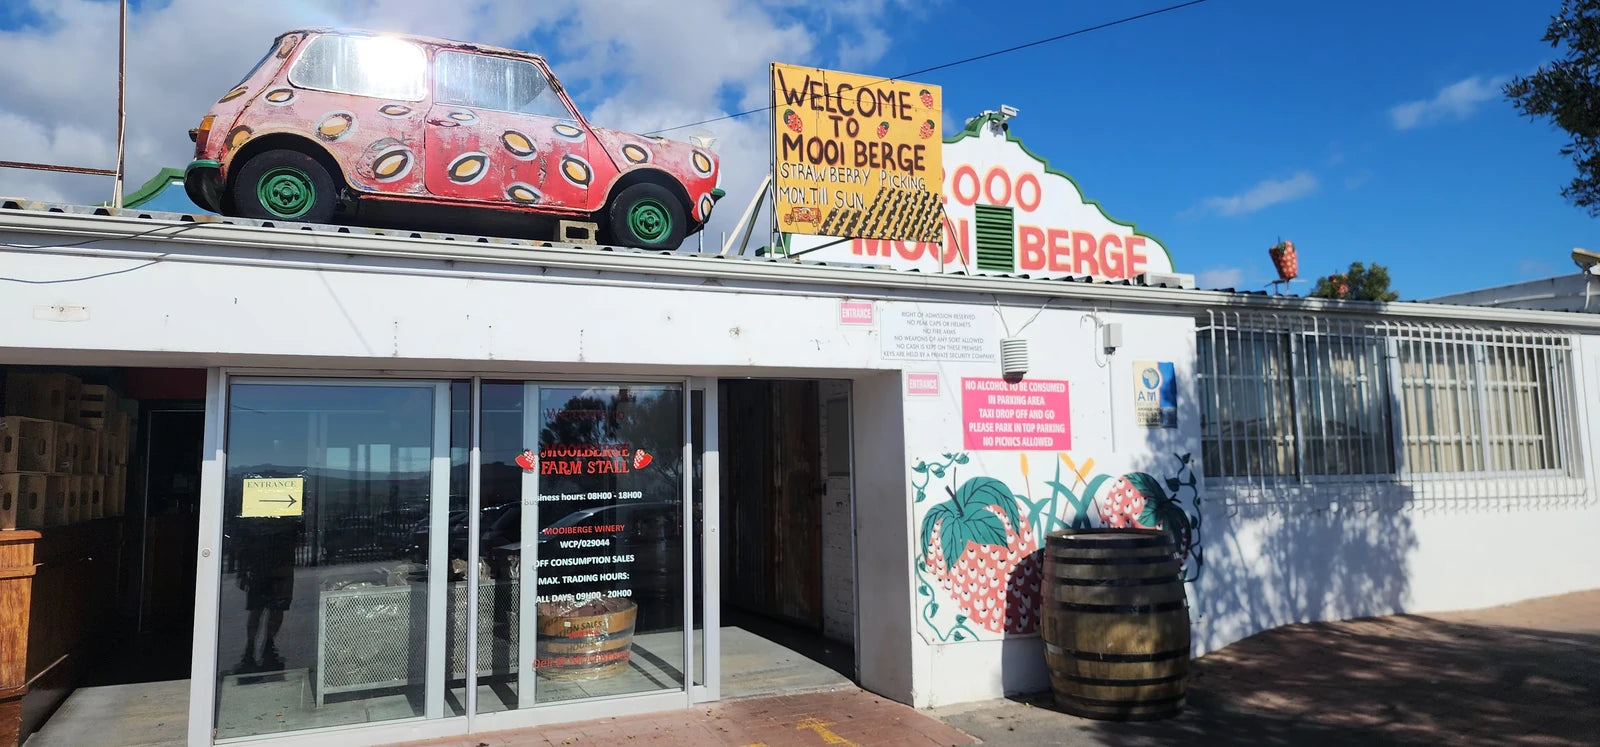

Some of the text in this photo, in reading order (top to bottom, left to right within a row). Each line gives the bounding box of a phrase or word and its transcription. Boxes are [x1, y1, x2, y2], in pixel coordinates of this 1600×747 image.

[778, 69, 912, 120] WELCOME
[829, 115, 859, 137] TO
[782, 133, 925, 176] MOOI BERGE
[942, 163, 1042, 212] 000
[1019, 224, 1148, 279] BERGE
[842, 308, 871, 319] ENTRANCE
[909, 379, 937, 389] ENTRANCE
[965, 380, 1066, 393] NO ALCOHOL TO BE CONSUMED
[988, 394, 1046, 406] IN PARKING AREA
[979, 408, 1055, 420] TAXI DROP OFF AND GO
[969, 422, 1066, 434] PLEASE PARK IN TOP PARKING
[982, 436, 1054, 447] NO PICNICS ALLOWED
[541, 460, 630, 476] FARM STALL
[247, 480, 296, 488] ENTRANCE
[562, 492, 586, 501] hours:
[588, 492, 612, 500] 08H00
[618, 491, 642, 499] 18H00
[544, 524, 626, 535] MOOIBERGE WINERY
[560, 538, 610, 550] WCP/029044
[533, 554, 635, 568] OFF CONSUMPTION SALES
[538, 572, 630, 586] MAX. TRADING HOURS:
[535, 595, 550, 604] ALL
[552, 594, 574, 602] DAYS:
[576, 592, 601, 600] 09H00
[607, 589, 632, 598] 20H00
